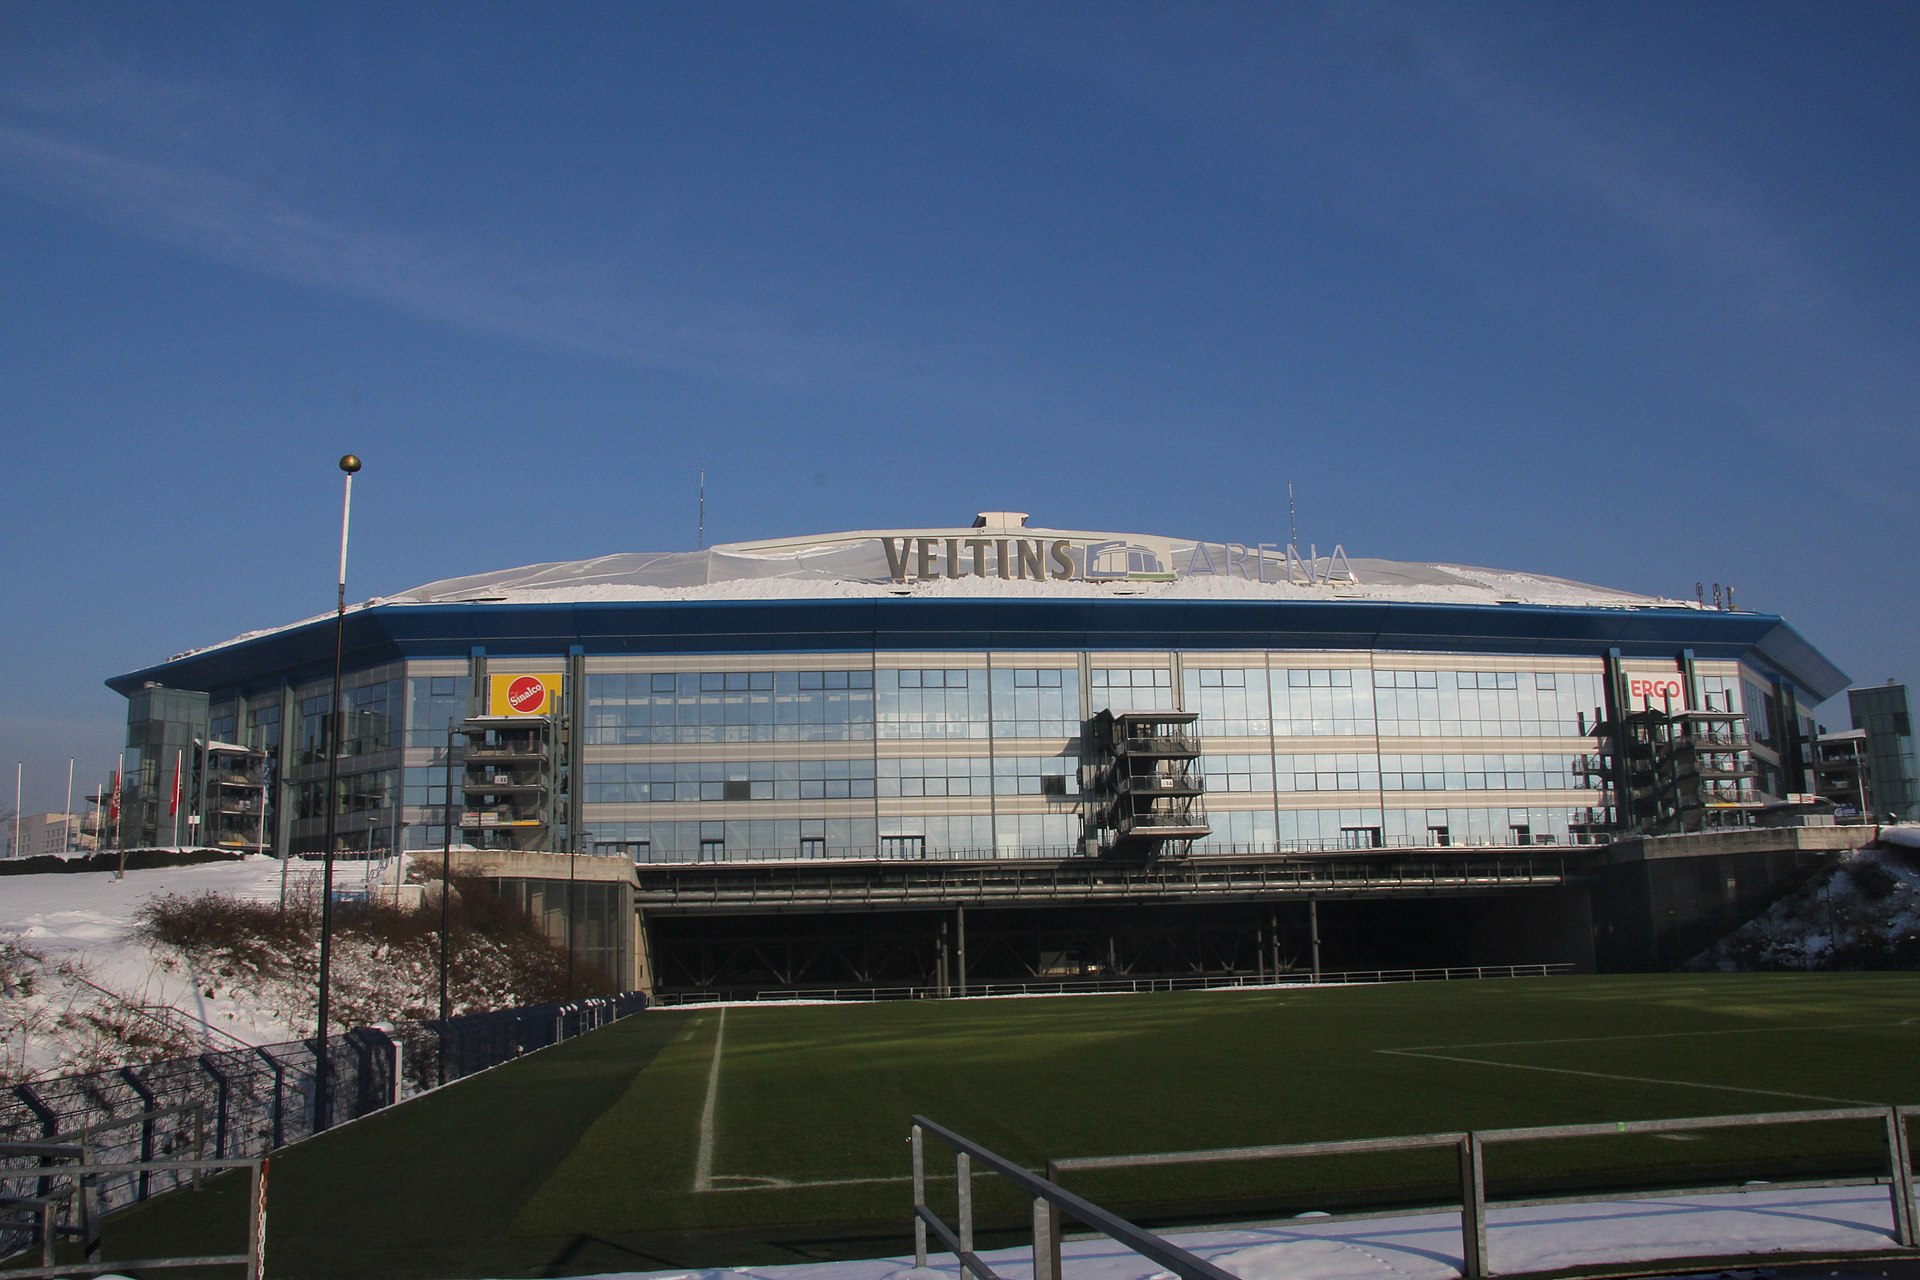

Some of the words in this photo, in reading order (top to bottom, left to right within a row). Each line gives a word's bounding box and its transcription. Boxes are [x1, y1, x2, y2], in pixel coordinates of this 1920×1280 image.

[881, 537, 1075, 581] VELTINS
[1187, 542, 1359, 585] ARENA
[510, 684, 542, 706] Sinalco
[1631, 680, 1680, 698] ERGO
